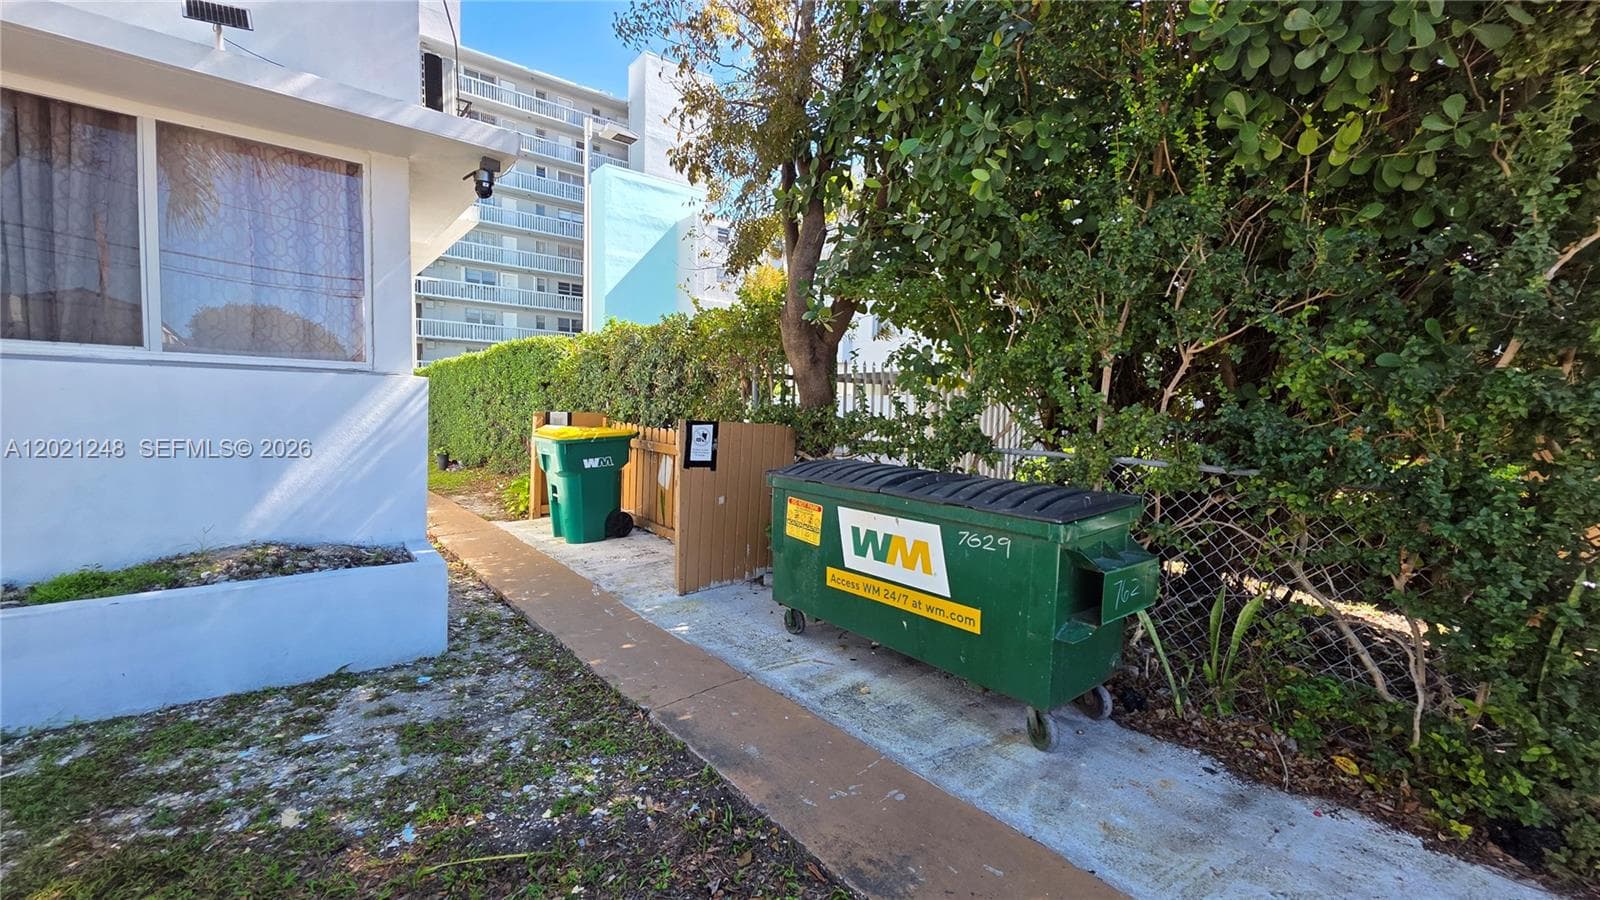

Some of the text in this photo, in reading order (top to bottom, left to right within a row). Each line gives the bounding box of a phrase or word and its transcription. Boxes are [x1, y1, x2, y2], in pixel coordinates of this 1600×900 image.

[583, 456, 614, 469] WM
[851, 525, 933, 576] WM
[958, 531, 1011, 559] 7629
[830, 573, 976, 628] Access WM 24/7 at wm.com
